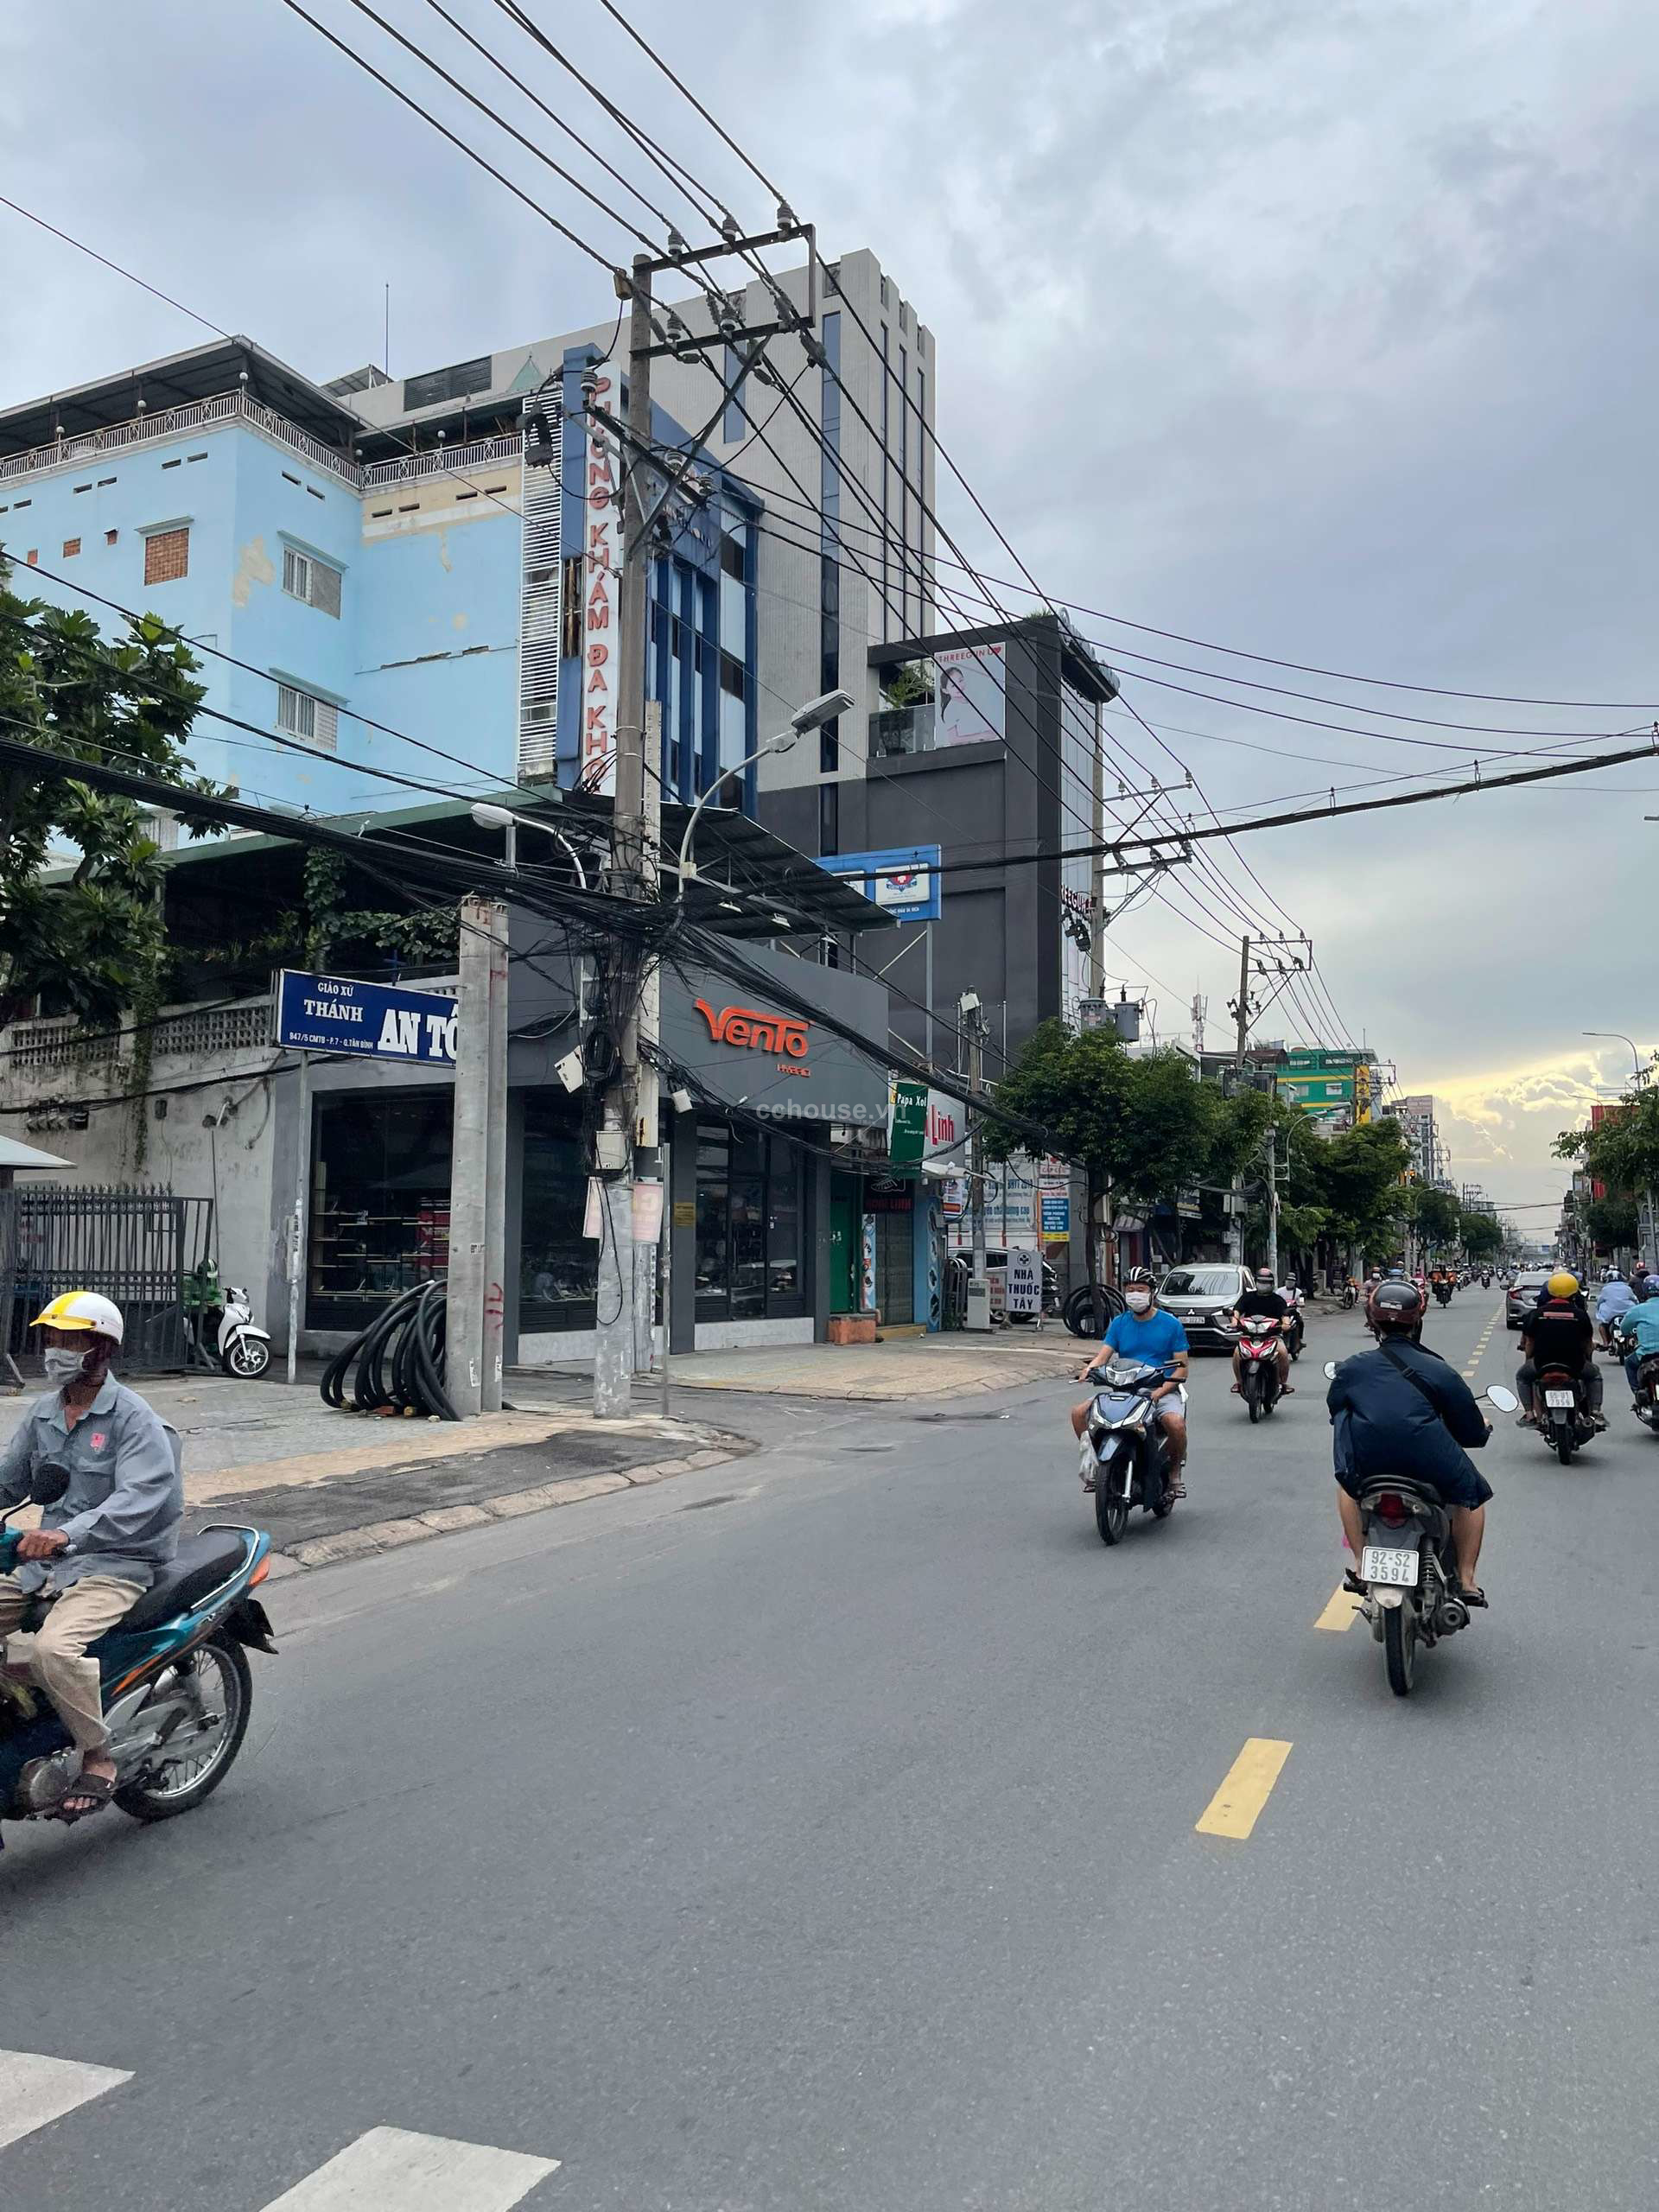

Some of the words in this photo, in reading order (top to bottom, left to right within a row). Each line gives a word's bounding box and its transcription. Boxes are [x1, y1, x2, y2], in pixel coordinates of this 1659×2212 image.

[588, 523, 609, 631] KHÁM
[588, 644, 609, 693] ĐA
[317, 982, 339, 995] GIÁO
[340, 985, 354, 997] XỨ
[303, 998, 363, 1023] THÁNH
[378, 1008, 421, 1055] AN
[897, 1093, 912, 1107] Papa
[1014, 1268, 1033, 1280] NHÀ
[1008, 1281, 1039, 1295] THUỐC
[1013, 1297, 1033, 1309] TÂY
[1371, 1551, 1410, 1567] 92-S2
[1370, 1566, 1409, 1582] 3594
